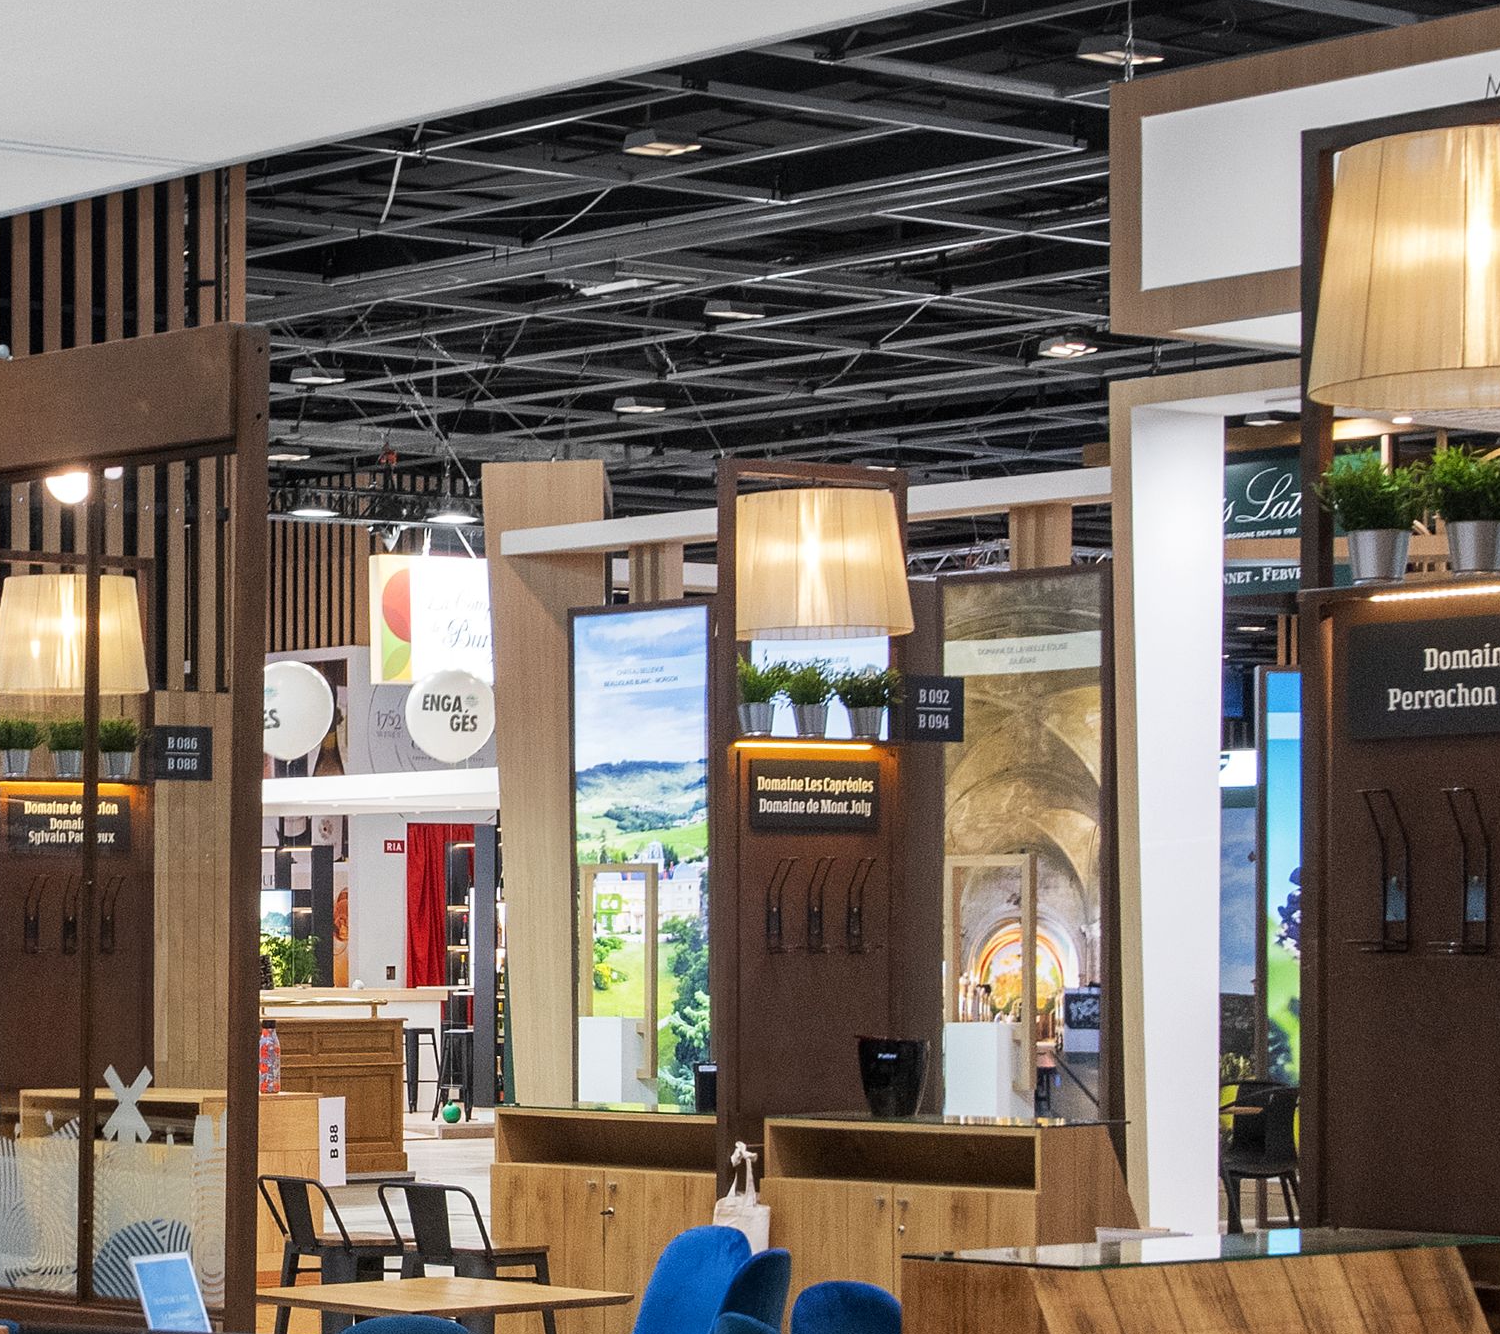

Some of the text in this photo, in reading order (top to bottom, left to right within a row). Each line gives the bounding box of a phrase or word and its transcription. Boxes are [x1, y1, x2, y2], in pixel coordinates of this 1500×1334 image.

[918, 689, 949, 704] B 092
[1388, 684, 1498, 711] Perrachon
[918, 714, 949, 729] B 094
[168, 737, 175, 750] B
[168, 757, 175, 770] B
[757, 776, 874, 795] Domaine Les Capréoles
[24, 801, 83, 815] Domaine de
[759, 798, 872, 817] Domaine de Mont Joly
[28, 830, 67, 845] Sylvain
[387, 842, 402, 852] RIA
[330, 1124, 340, 1160] B 88
